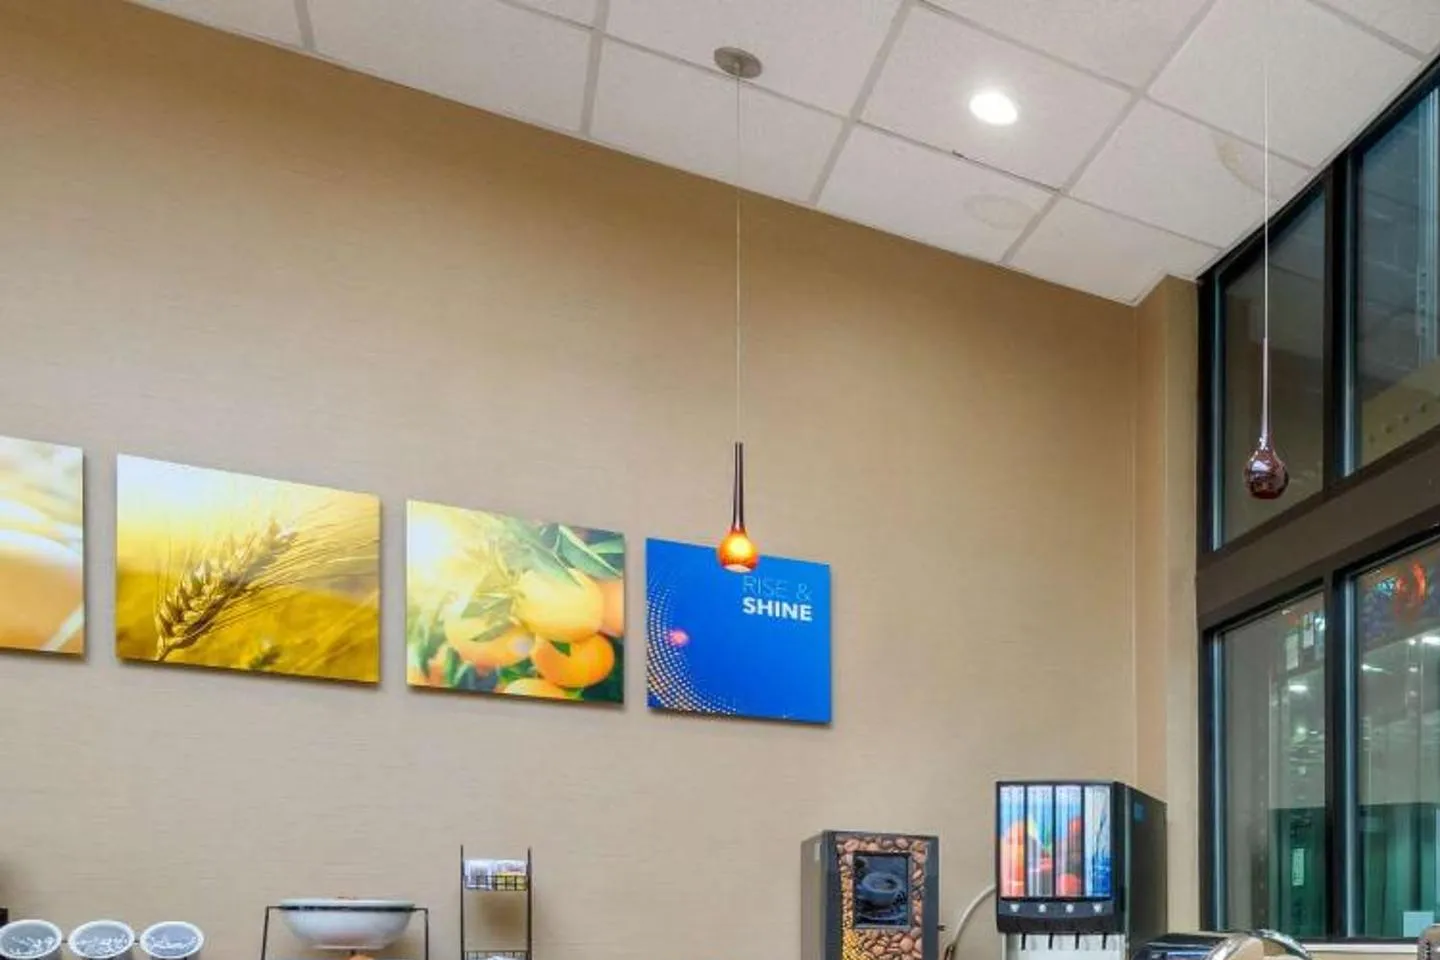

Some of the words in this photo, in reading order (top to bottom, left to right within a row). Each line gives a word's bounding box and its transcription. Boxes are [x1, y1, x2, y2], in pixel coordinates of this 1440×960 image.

[743, 575, 788, 599] RISE
[796, 583, 812, 601] &
[742, 596, 813, 622] SHINE
